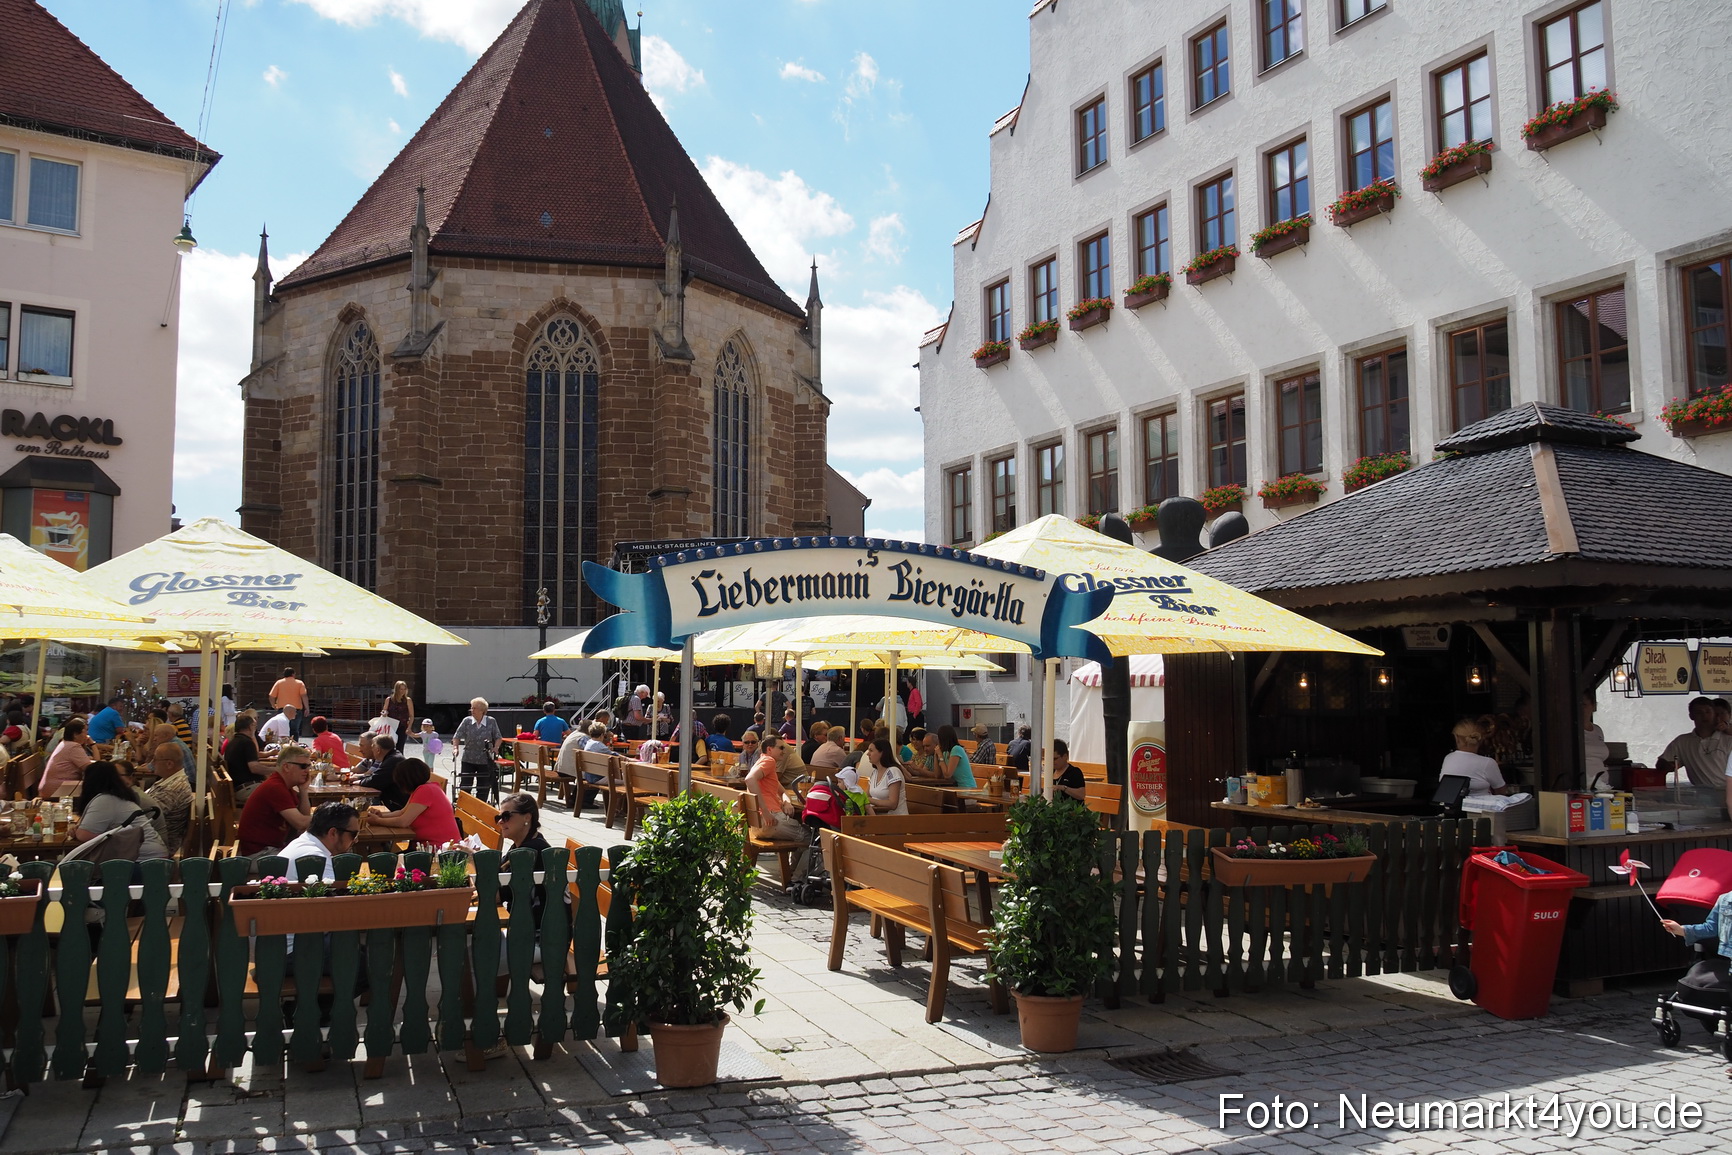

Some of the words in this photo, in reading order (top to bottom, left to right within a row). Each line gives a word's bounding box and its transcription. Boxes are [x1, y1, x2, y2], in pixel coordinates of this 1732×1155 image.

[1, 408, 123, 446] RACKL
[15, 443, 41, 453] am
[45, 440, 110, 460] Rathaus
[632, 541, 716, 550] MOBILE-STAGES.INFO
[128, 571, 304, 606] Glossner
[690, 549, 880, 618] Liebermann's
[886, 558, 1026, 626] Biergärtla
[1058, 572, 1188, 596] Glossner
[226, 590, 309, 612] Bier
[1148, 594, 1221, 617] Bier
[1103, 612, 1176, 625] hochfeine
[1181, 614, 1268, 633] Biergenuss
[1644, 647, 1667, 664] Steak
[1533, 911, 1559, 920] SULO
